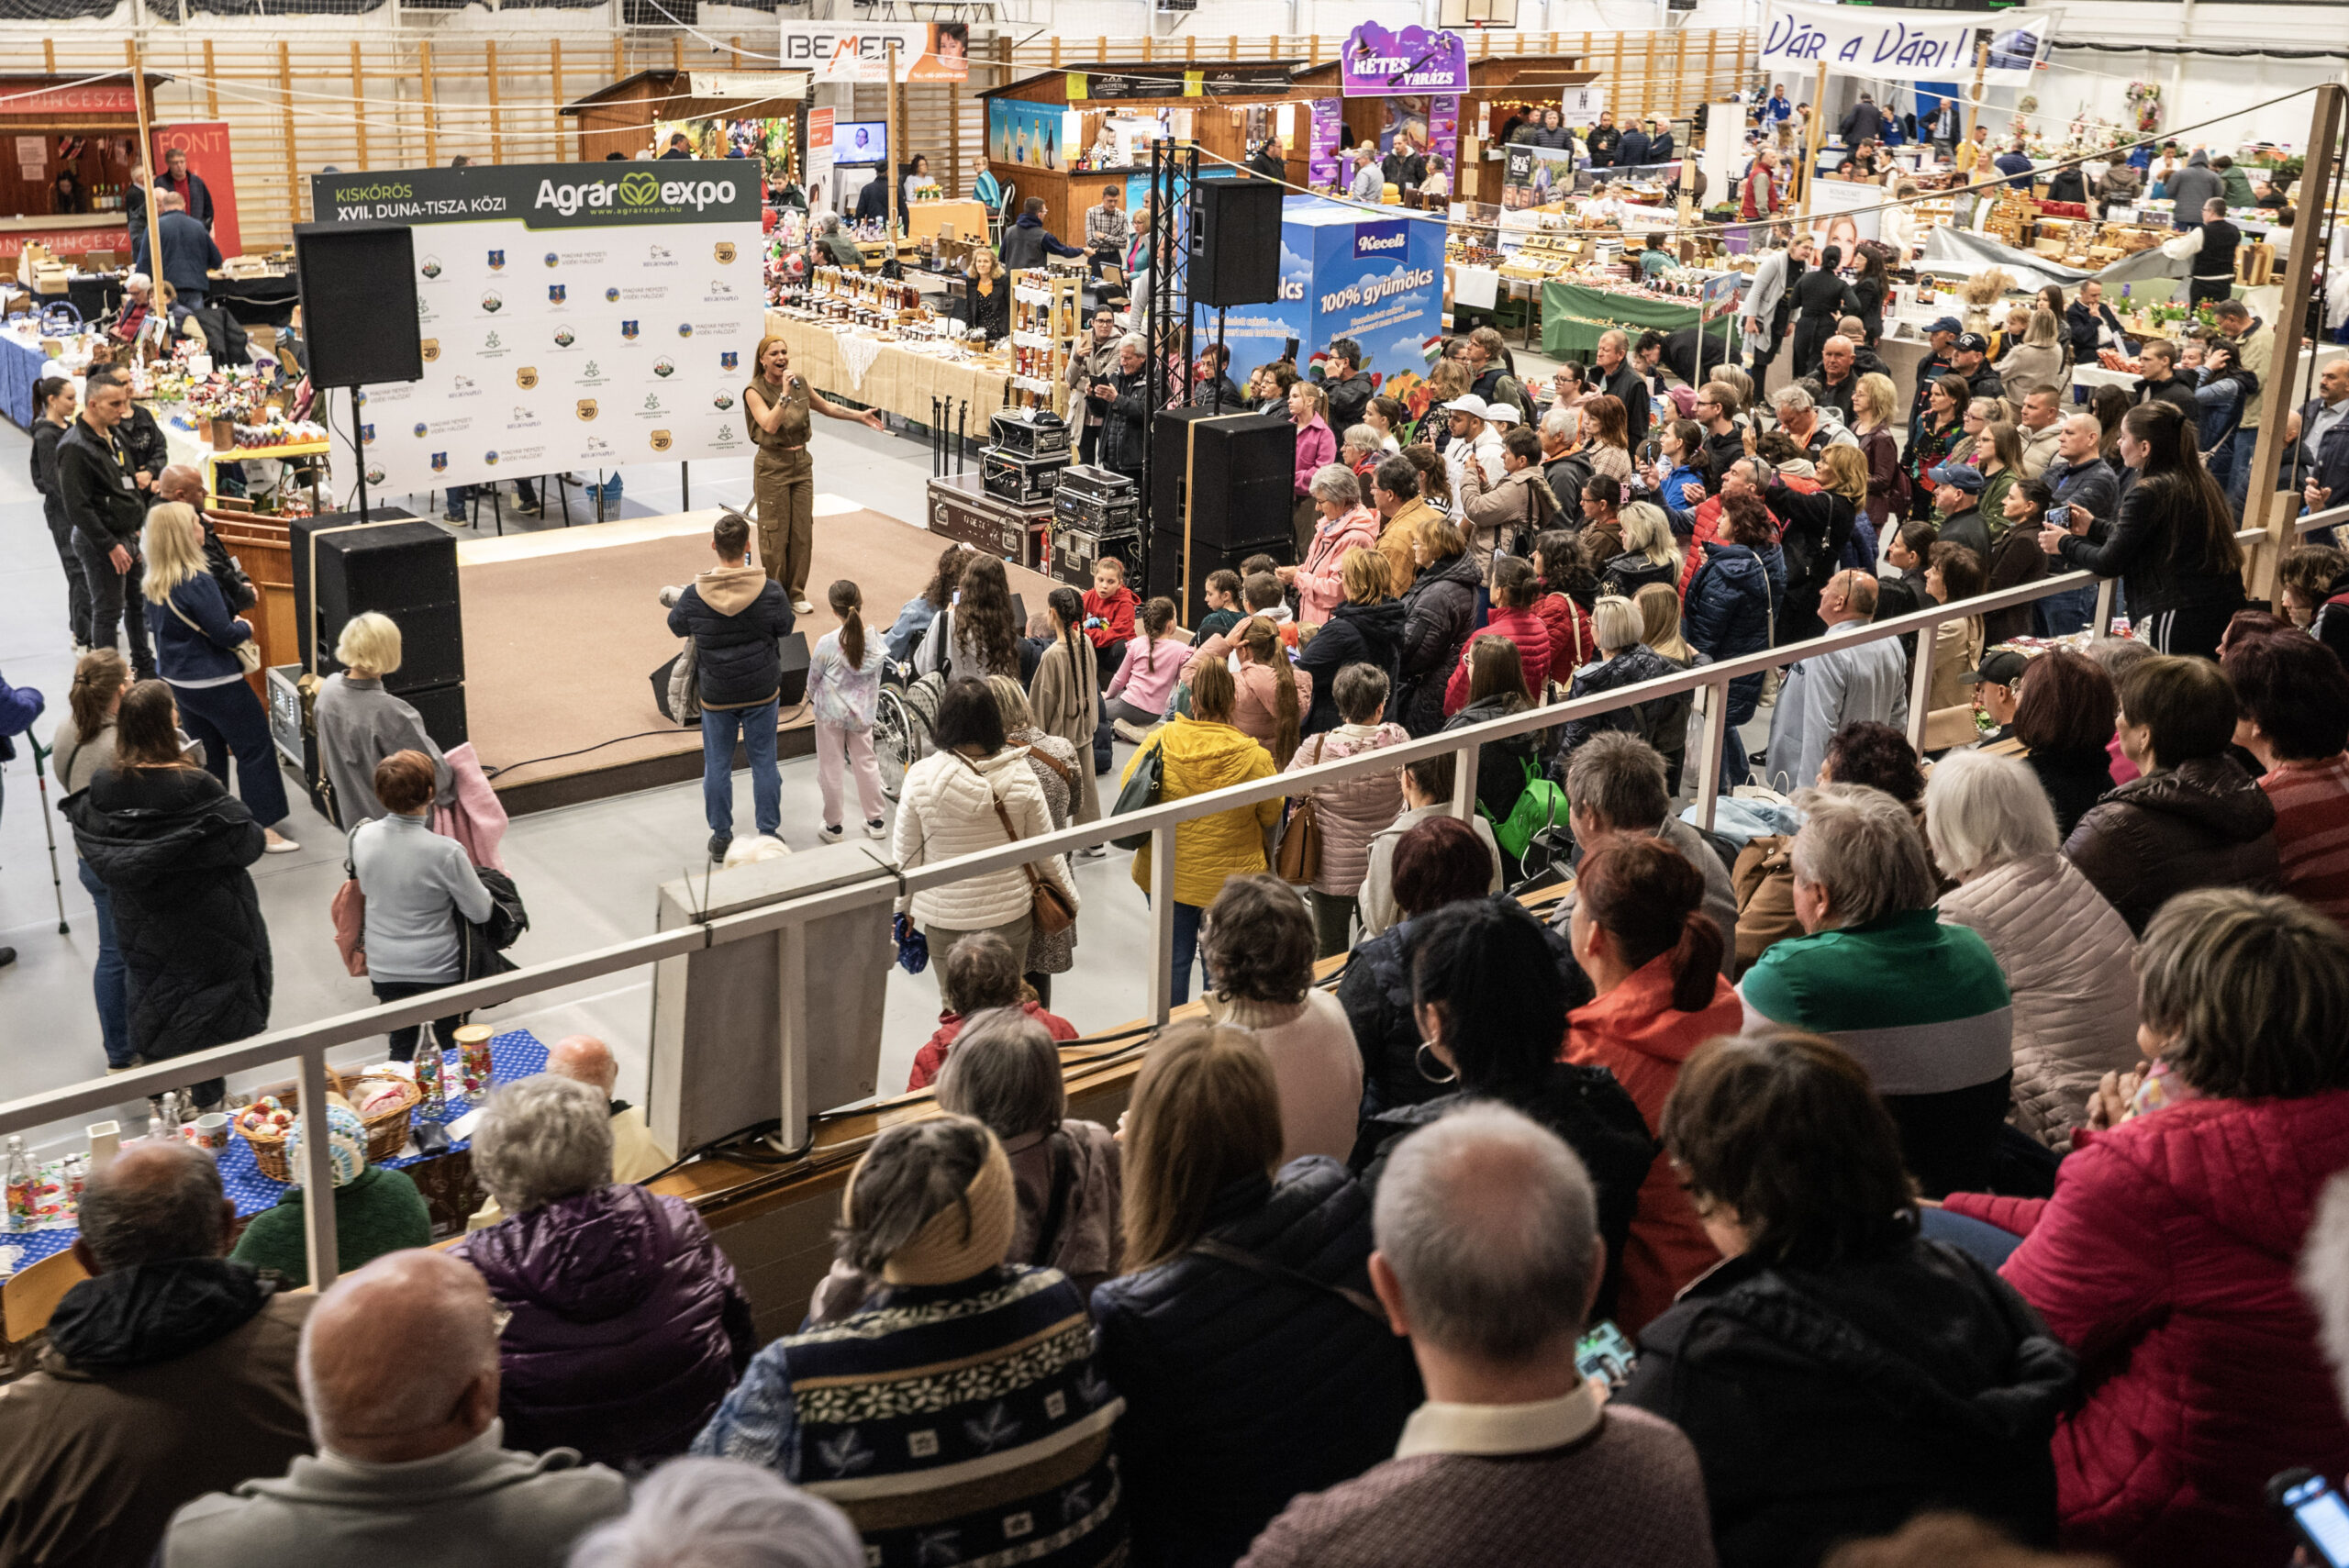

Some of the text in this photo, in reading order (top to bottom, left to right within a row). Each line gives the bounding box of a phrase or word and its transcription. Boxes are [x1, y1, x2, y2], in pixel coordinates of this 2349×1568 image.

[1763, 14, 1826, 60] VÁR
[1838, 36, 1864, 62] A
[787, 35, 905, 73] BEMER
[1353, 55, 1411, 75] RÉTES
[1403, 69, 1455, 86] VARÁZS
[158, 131, 224, 155] FONT
[335, 183, 413, 203] KISKŐRÖS
[535, 179, 735, 217] Agrár expo
[337, 196, 507, 222] XVII. DUNA-TISZA KÖZI
[590, 206, 682, 216] www.agrarexpo.hu
[44, 233, 128, 250] PINCÉSZ
[1358, 233, 1406, 251] Keceli
[1320, 286, 1361, 314] 100%
[1364, 268, 1433, 306] gyümölcs
